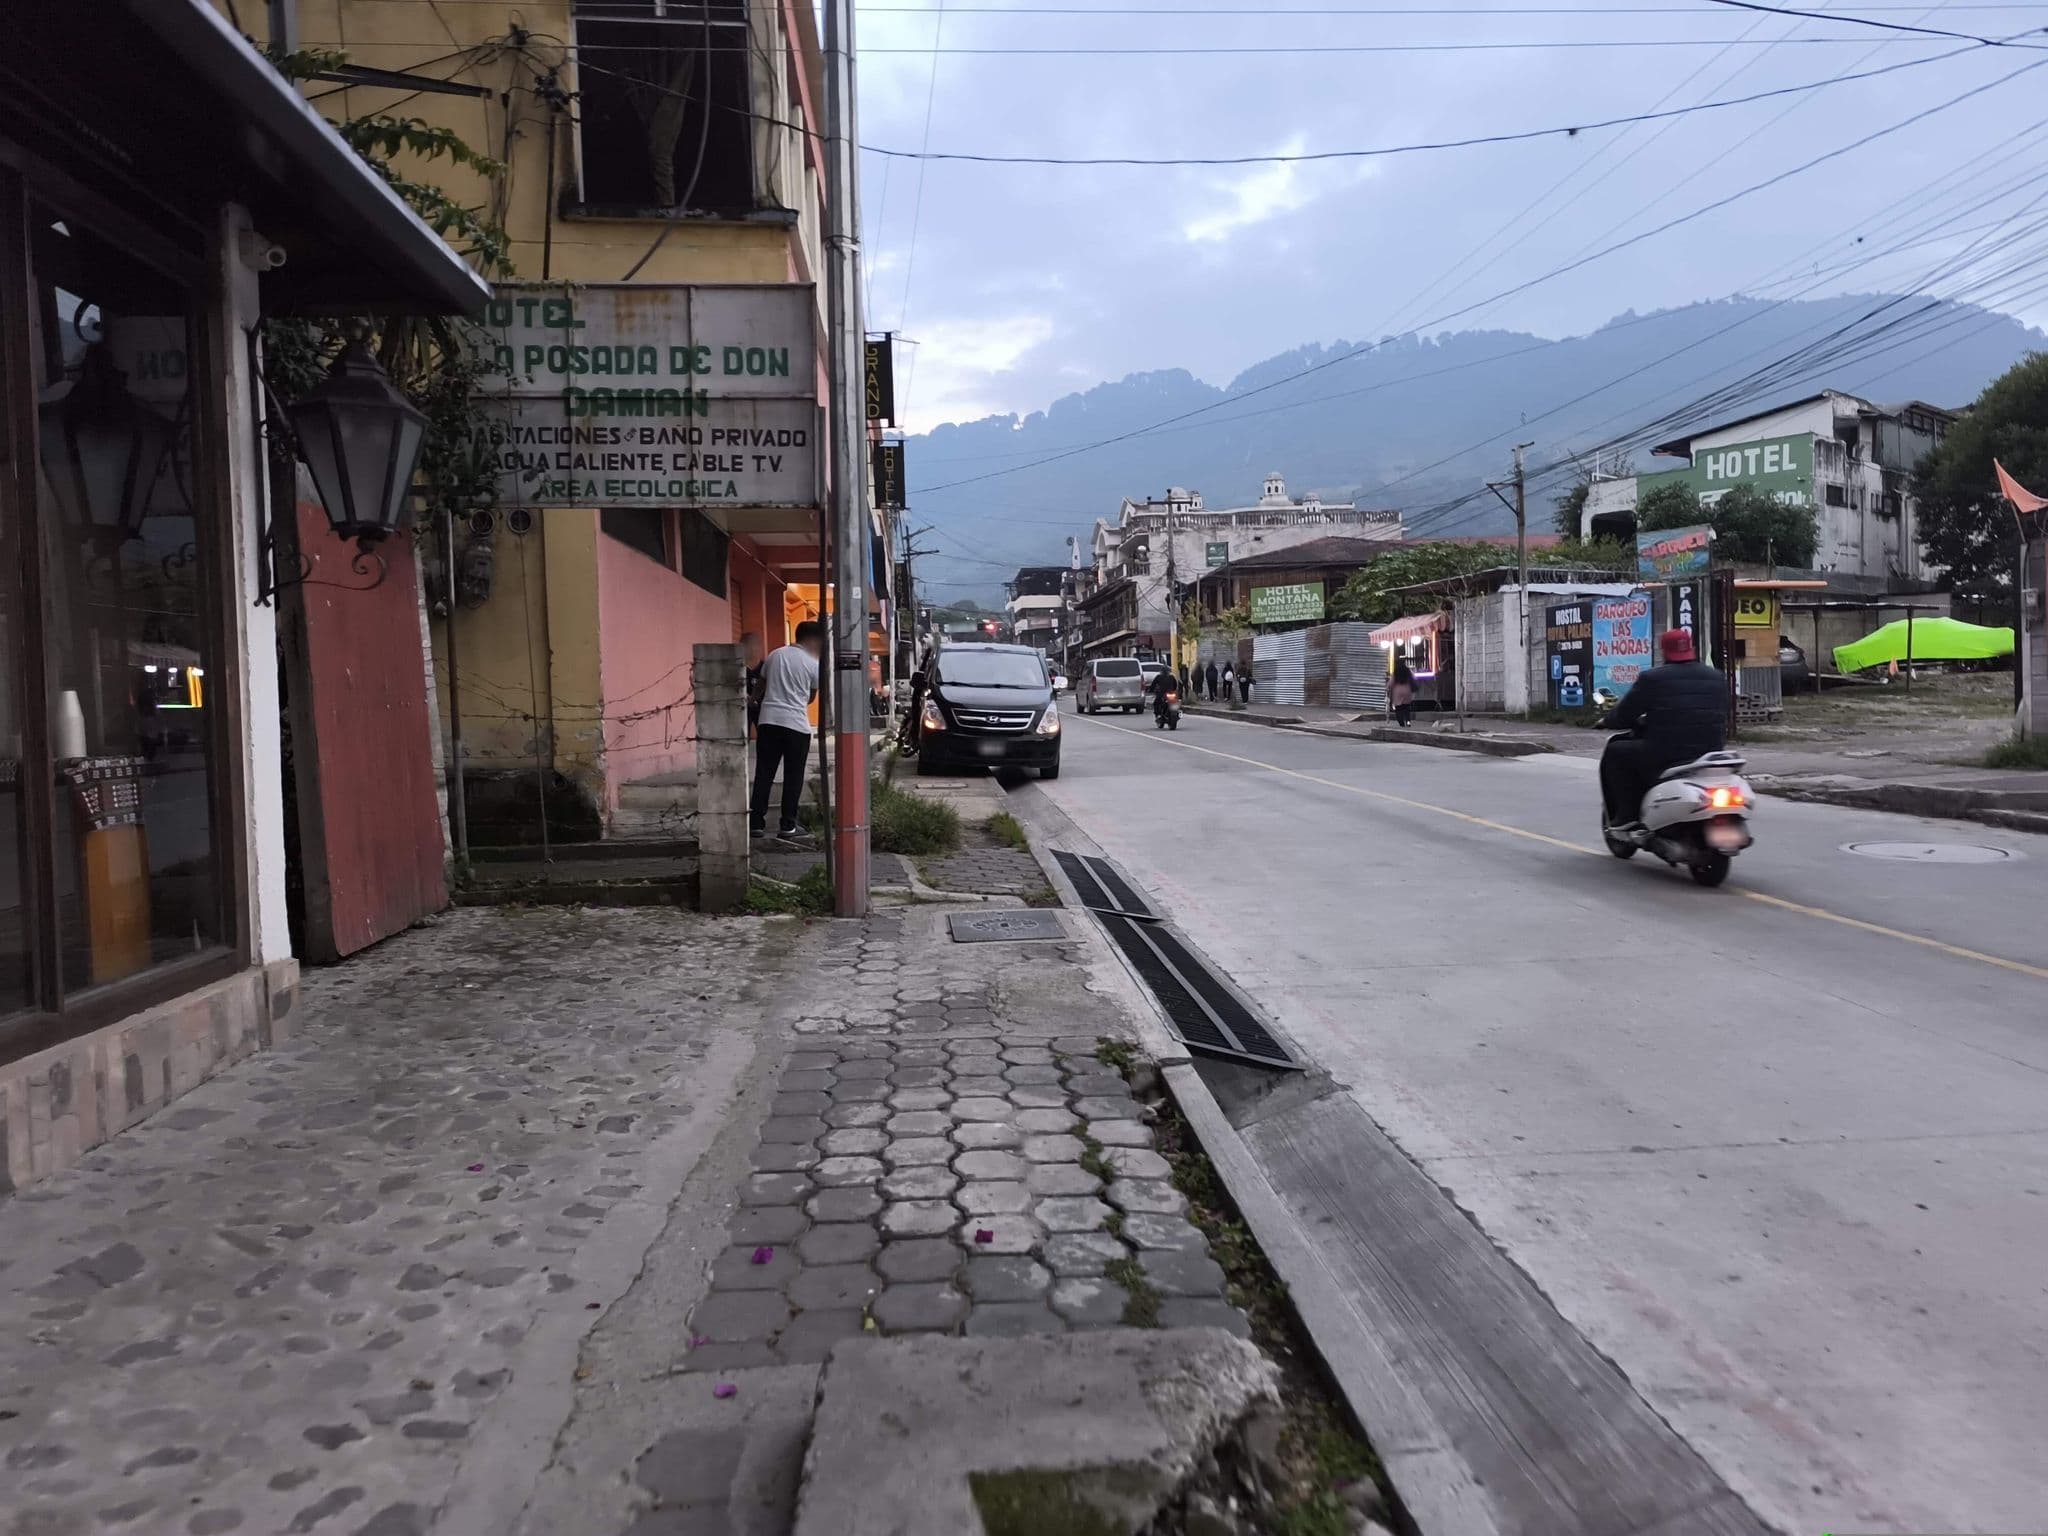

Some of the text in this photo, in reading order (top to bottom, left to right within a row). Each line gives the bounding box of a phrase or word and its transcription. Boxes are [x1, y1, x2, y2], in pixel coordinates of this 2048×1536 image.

[525, 345, 658, 375] POSADA
[670, 346, 712, 375] DE
[723, 347, 790, 377] DON
[866, 342, 880, 418] GRAND
[562, 387, 709, 418] DAMIAN
[711, 428, 807, 447] PRIVADO
[673, 453, 744, 472] CABLE
[1707, 443, 1797, 480] HOTEL
[605, 479, 739, 498] ECOLOGICA
[1266, 585, 1310, 596] HOTEL
[1555, 607, 1582, 626] HOSTAL
[1597, 601, 1647, 619] PARQUEO
[1612, 621, 1632, 637] LAS
[1611, 638, 1649, 655] HORAS
